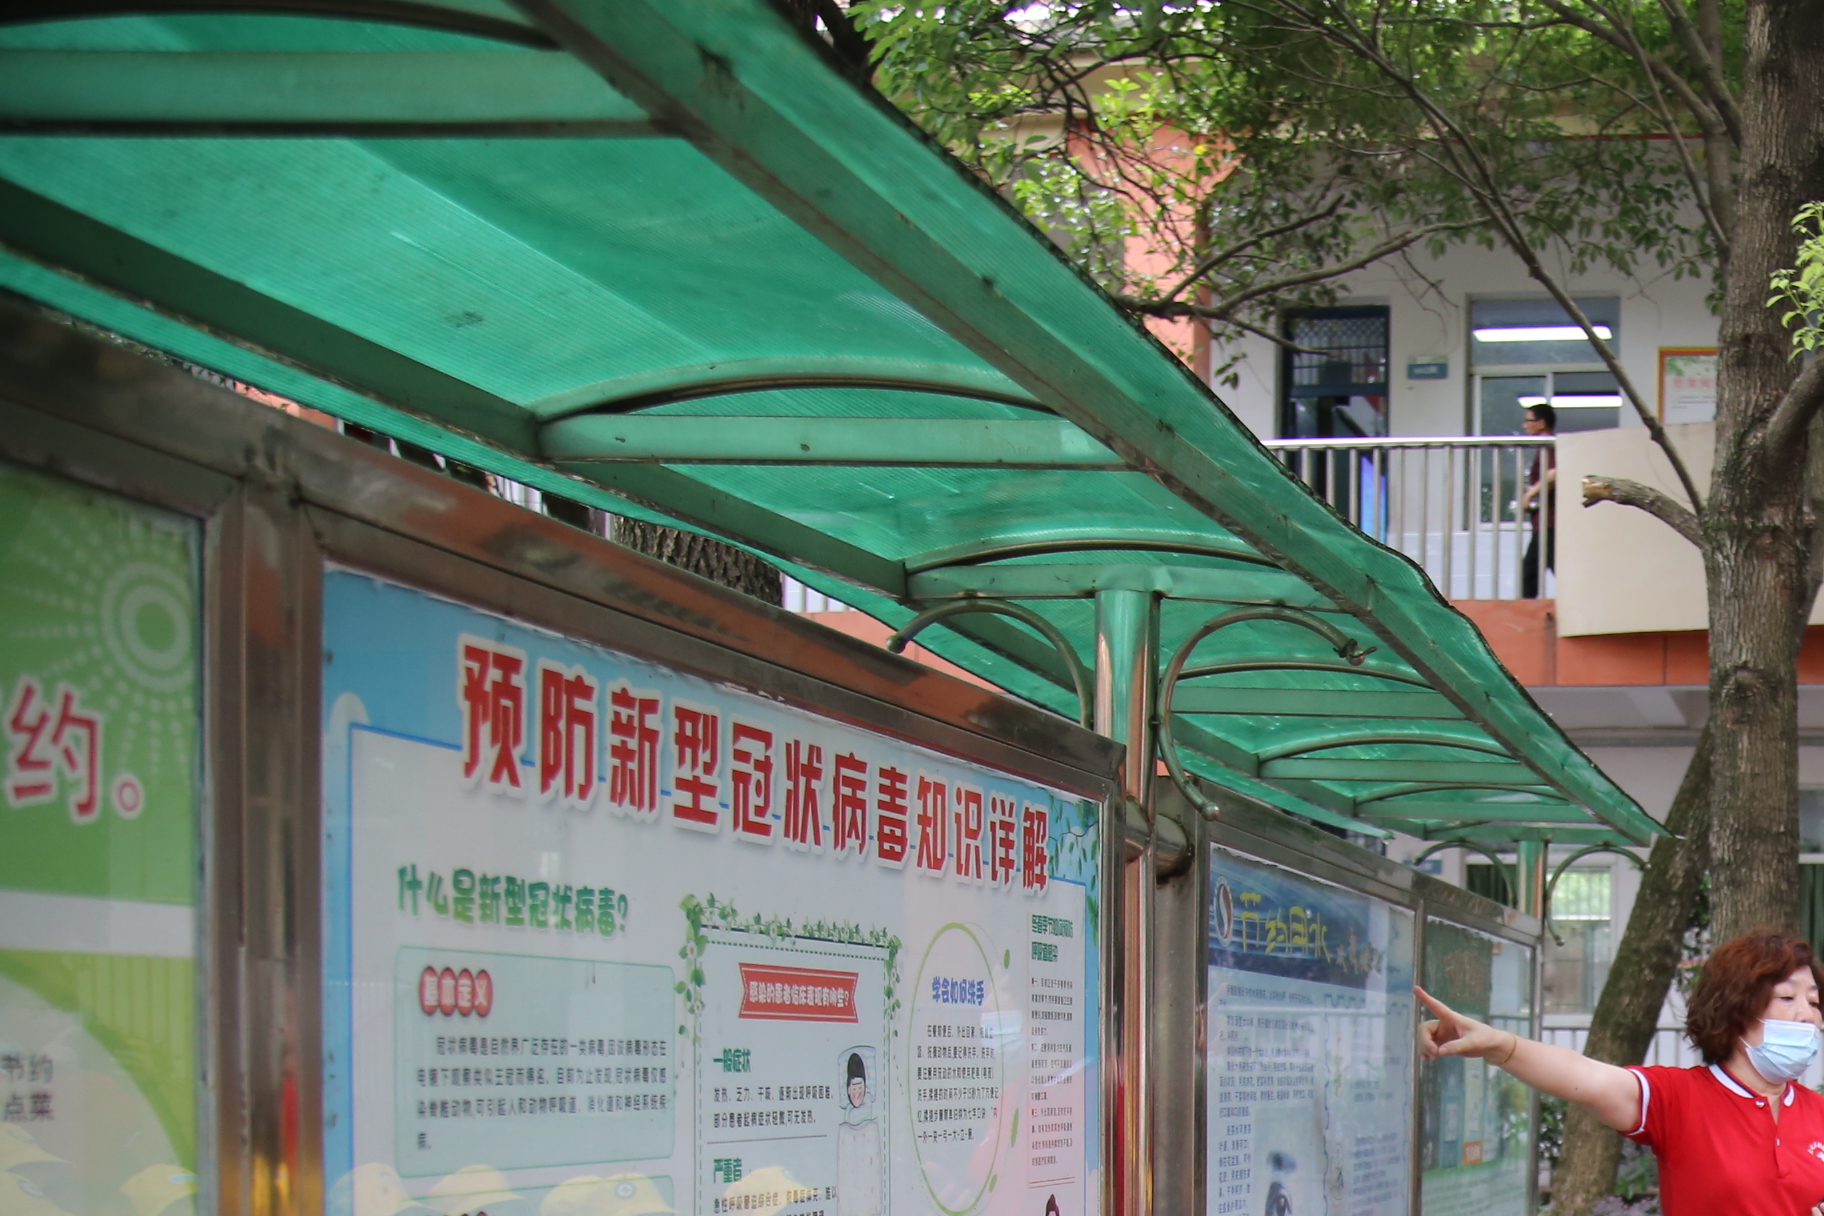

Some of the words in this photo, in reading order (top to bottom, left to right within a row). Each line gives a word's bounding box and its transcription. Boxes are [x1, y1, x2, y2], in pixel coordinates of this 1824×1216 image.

[462, 645, 1049, 892] 预防新型冠状病毒知识详解
[397, 863, 629, 937] 什么是新型冠状病毒？
[423, 974, 490, 1008] 基本定义
[932, 976, 985, 1007] 学会如何洗手
[713, 1048, 752, 1073] 一般症状
[713, 1157, 743, 1185] 严重者
